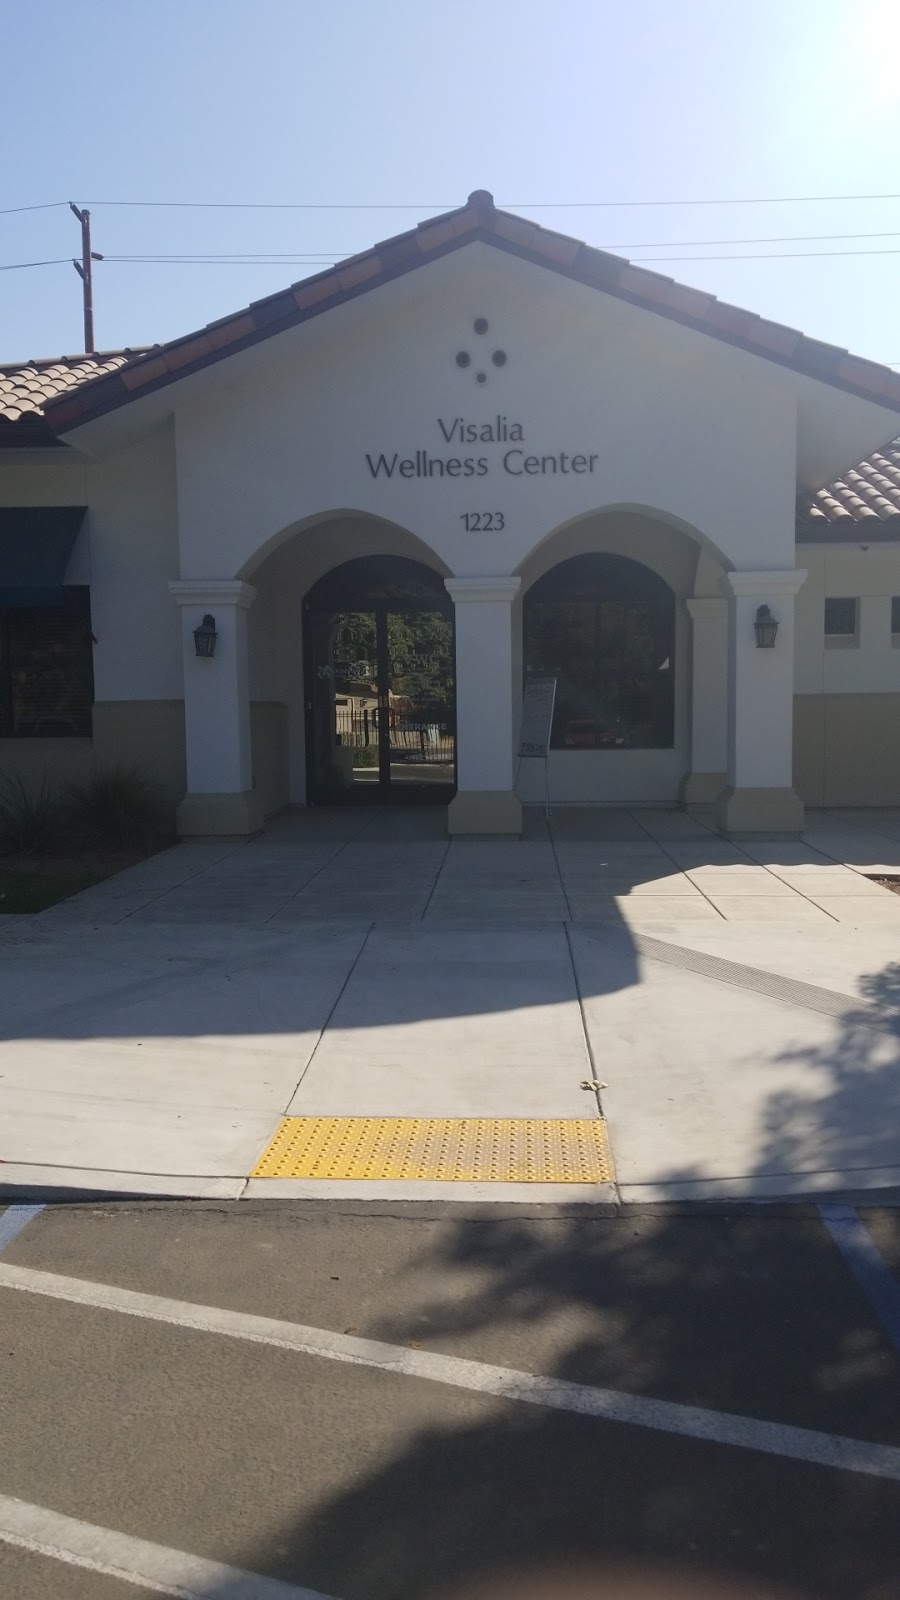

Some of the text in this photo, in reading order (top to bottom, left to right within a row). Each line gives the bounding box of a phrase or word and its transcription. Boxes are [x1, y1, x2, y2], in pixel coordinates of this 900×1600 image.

[437, 415, 525, 443] Visalia
[366, 450, 599, 478] Wellness Center
[460, 512, 506, 532] 1223
